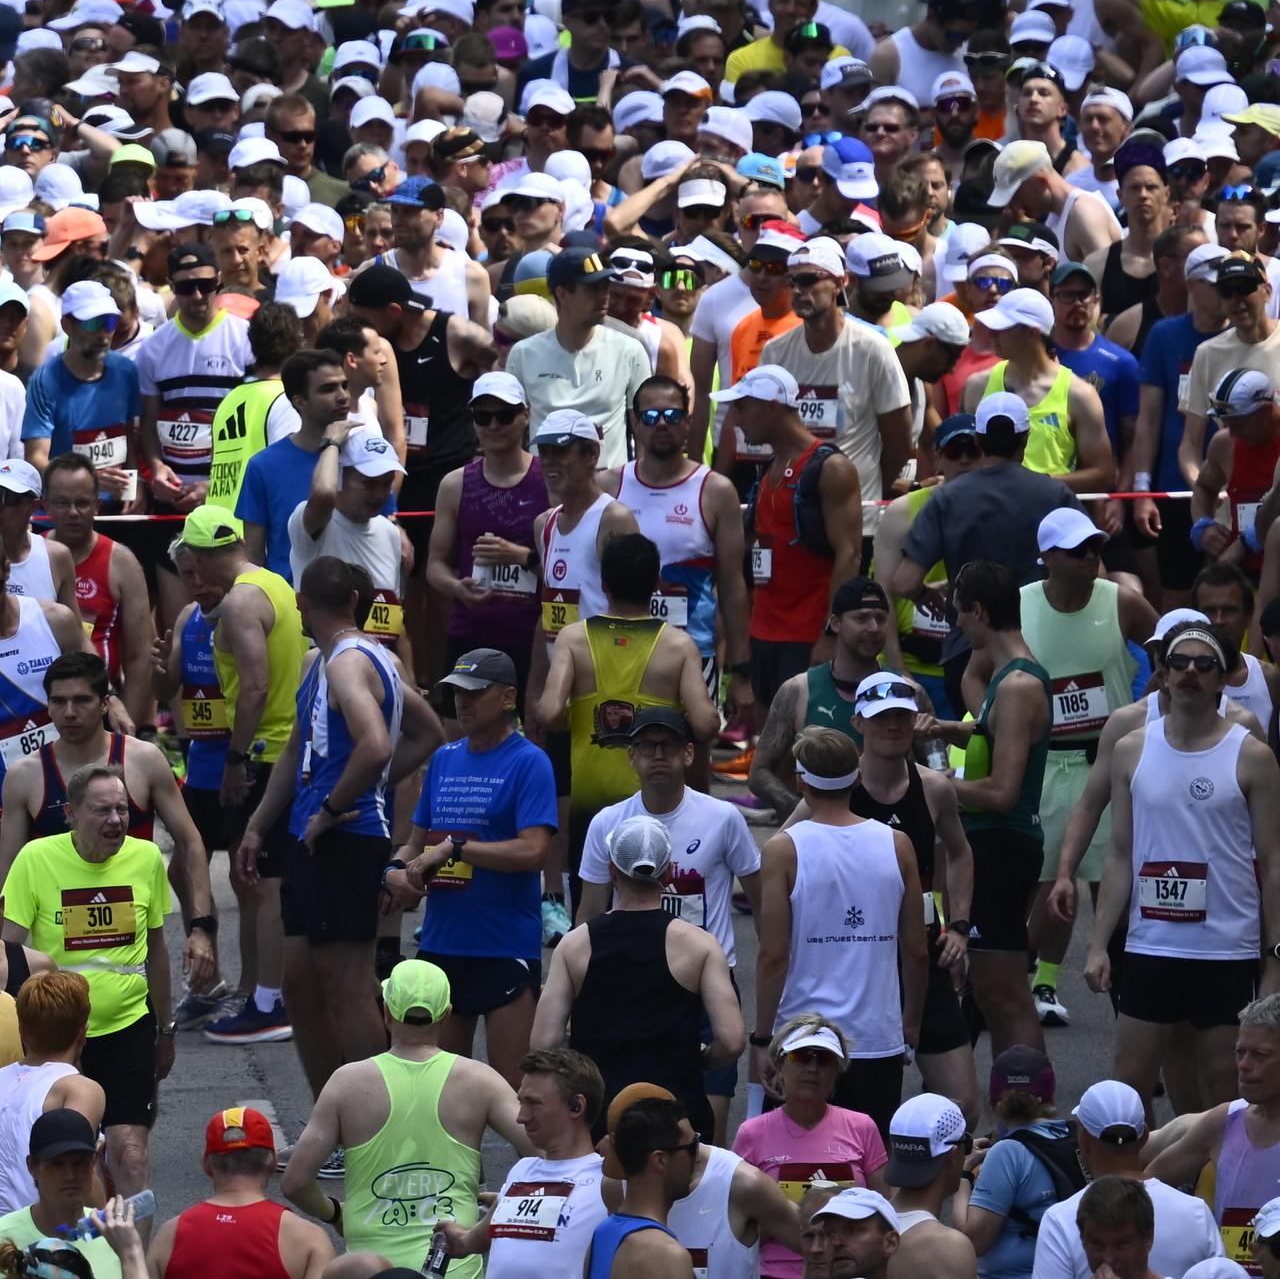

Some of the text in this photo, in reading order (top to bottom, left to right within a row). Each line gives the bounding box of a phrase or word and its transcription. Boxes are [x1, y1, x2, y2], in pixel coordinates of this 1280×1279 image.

[169, 424, 199, 442] 4227
[89, 441, 114, 461] 1940
[370, 606, 390, 625] 412
[551, 605, 567, 624] 312
[192, 702, 212, 721] 345
[1058, 692, 1090, 715] 1185
[20, 729, 46, 756] 852
[1155, 879, 1188, 901] 1347
[87, 906, 113, 928] 310
[516, 1198, 544, 1217] 914
